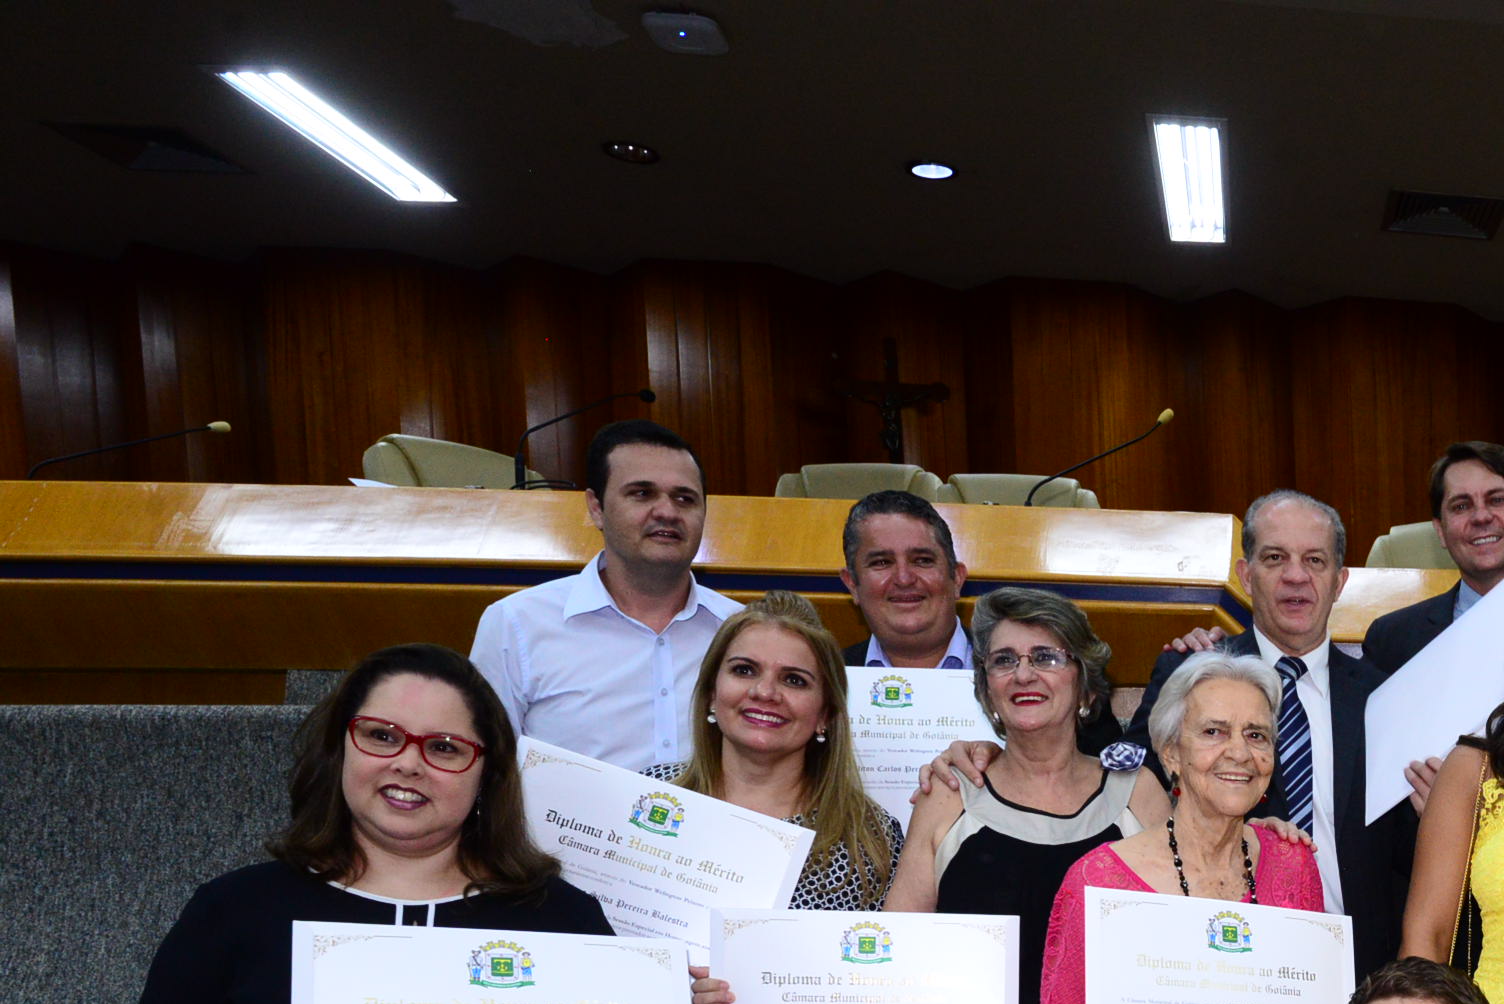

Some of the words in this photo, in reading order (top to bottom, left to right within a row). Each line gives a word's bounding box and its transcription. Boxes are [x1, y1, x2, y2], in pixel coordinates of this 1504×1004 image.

[545, 809, 603, 838] Diploma
[608, 829, 624, 845] de
[675, 855, 693, 868] ao
[697, 859, 745, 884] Mérito
[558, 834, 600, 856] Câmara
[603, 849, 658, 874] Municipal
[761, 971, 822, 988] Diploma
[828, 972, 843, 986] de
[1277, 966, 1316, 982] Mérito
[781, 991, 826, 1003] Câmara
[1265, 984, 1301, 997] Goiânia
